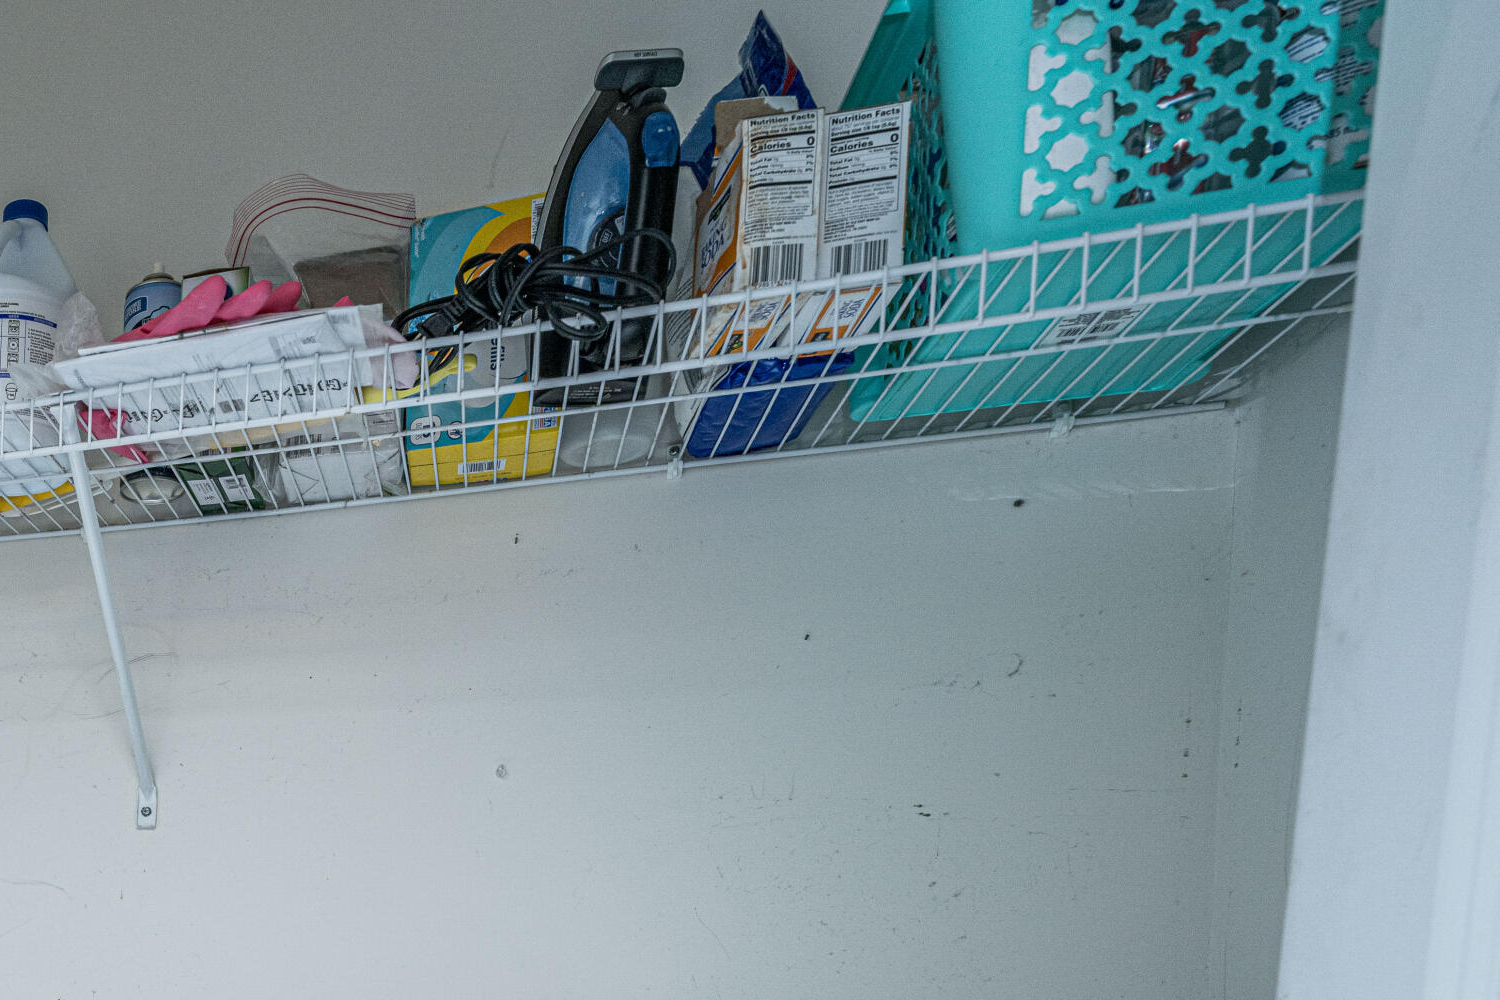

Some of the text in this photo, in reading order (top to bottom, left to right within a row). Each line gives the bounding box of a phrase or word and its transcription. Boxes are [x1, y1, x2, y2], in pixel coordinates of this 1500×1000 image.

[750, 117, 789, 127] Nutrition
[791, 113, 815, 121] Facts
[832, 113, 872, 125] Nutrition
[875, 108, 901, 117] Facts
[750, 136, 815, 153] Calories 0
[830, 141, 874, 153] Calories
[890, 133, 899, 142] 0
